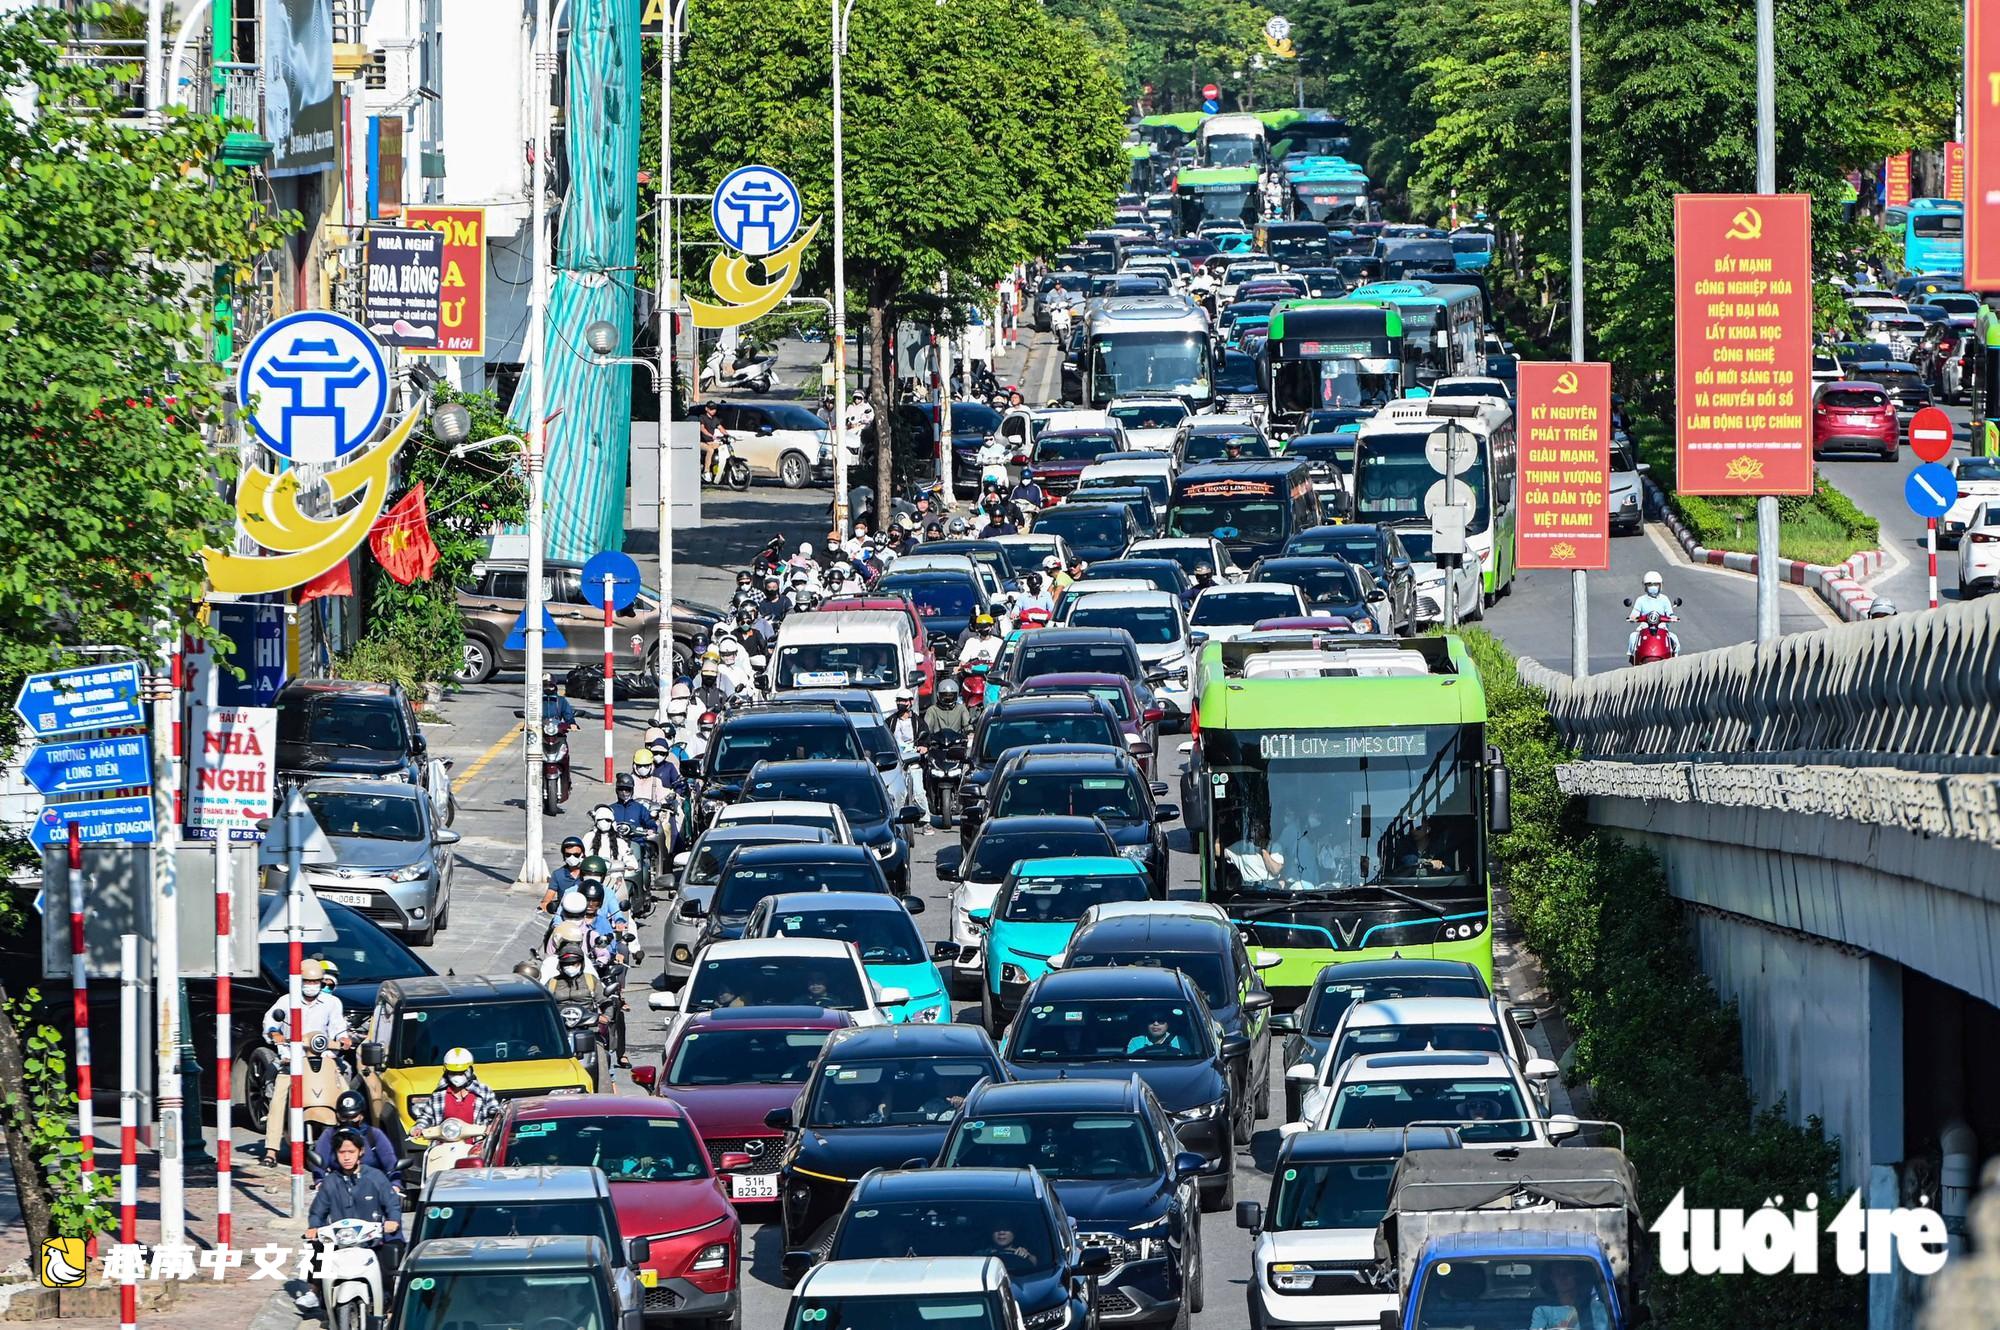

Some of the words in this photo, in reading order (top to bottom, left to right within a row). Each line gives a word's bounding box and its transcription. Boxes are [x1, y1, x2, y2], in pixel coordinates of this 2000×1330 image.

[412, 216, 478, 247] ƠM
[378, 236, 402, 250] NHÀ
[404, 236, 434, 252] NGHỈ
[368, 264, 398, 292] HOA
[400, 252, 439, 294] HỒNG
[1739, 258, 1772, 274] MẠNH
[1695, 278, 1724, 294] CÔNG
[1728, 278, 1768, 297] NGHIỆP
[1770, 278, 1792, 294] HÓA
[1708, 301, 1734, 320] HIỆN
[1736, 304, 1754, 320] ĐẠI
[1758, 301, 1779, 317] HÓA
[1706, 322, 1726, 340] LẤY
[1728, 326, 1758, 340] KHOA
[1760, 326, 1782, 342] HỌC
[448, 337, 474, 349] Mời
[1714, 346, 1743, 362] CÔNG
[1746, 346, 1775, 364] NGHỆ
[1716, 368, 1738, 384] MỚI
[1740, 368, 1770, 384] SÁNG
[1772, 370, 1793, 386] TẠO
[1696, 391, 1709, 407] VÀ
[1778, 388, 1794, 406] SỐ
[1532, 404, 1546, 420] KỶ
[1550, 404, 1597, 420] NGUYÊN
[1688, 414, 1710, 429] LÀM
[1714, 413, 1742, 431] ĐỘNG
[1746, 414, 1766, 431] LỰC
[1768, 413, 1802, 428] CHÍNH
[1531, 426, 1560, 440] PHÁT
[1530, 447, 1556, 462] GIÀU
[1560, 450, 1598, 464] MẠNH,
[1526, 470, 1560, 486] THỊNH
[1563, 470, 1602, 486] VƯỢNG
[1526, 488, 1550, 504] CỦA
[1552, 490, 1576, 504] DÂN
[1580, 490, 1602, 508] TỘC
[1534, 510, 1558, 528] VIỆT
[1561, 514, 1592, 526] NAM!
[203, 728, 262, 755] NHÀ
[1302, 738, 1328, 754] CITY
[1345, 737, 1382, 753] TIMES
[1387, 736, 1414, 752] CITY
[46, 746, 86, 763] TRƯỜNG
[90, 742, 114, 759] MẦM
[118, 743, 140, 756] NON
[66, 766, 92, 780] LONG
[95, 762, 118, 776] BIÊN
[196, 762, 266, 792] NGHỈ
[50, 826, 69, 840] CÔN
[90, 822, 112, 839] LUẬT
[115, 820, 152, 834] DRAGON
[746, 1178, 764, 1186] 51H
[738, 1187, 772, 1196] 829.22
